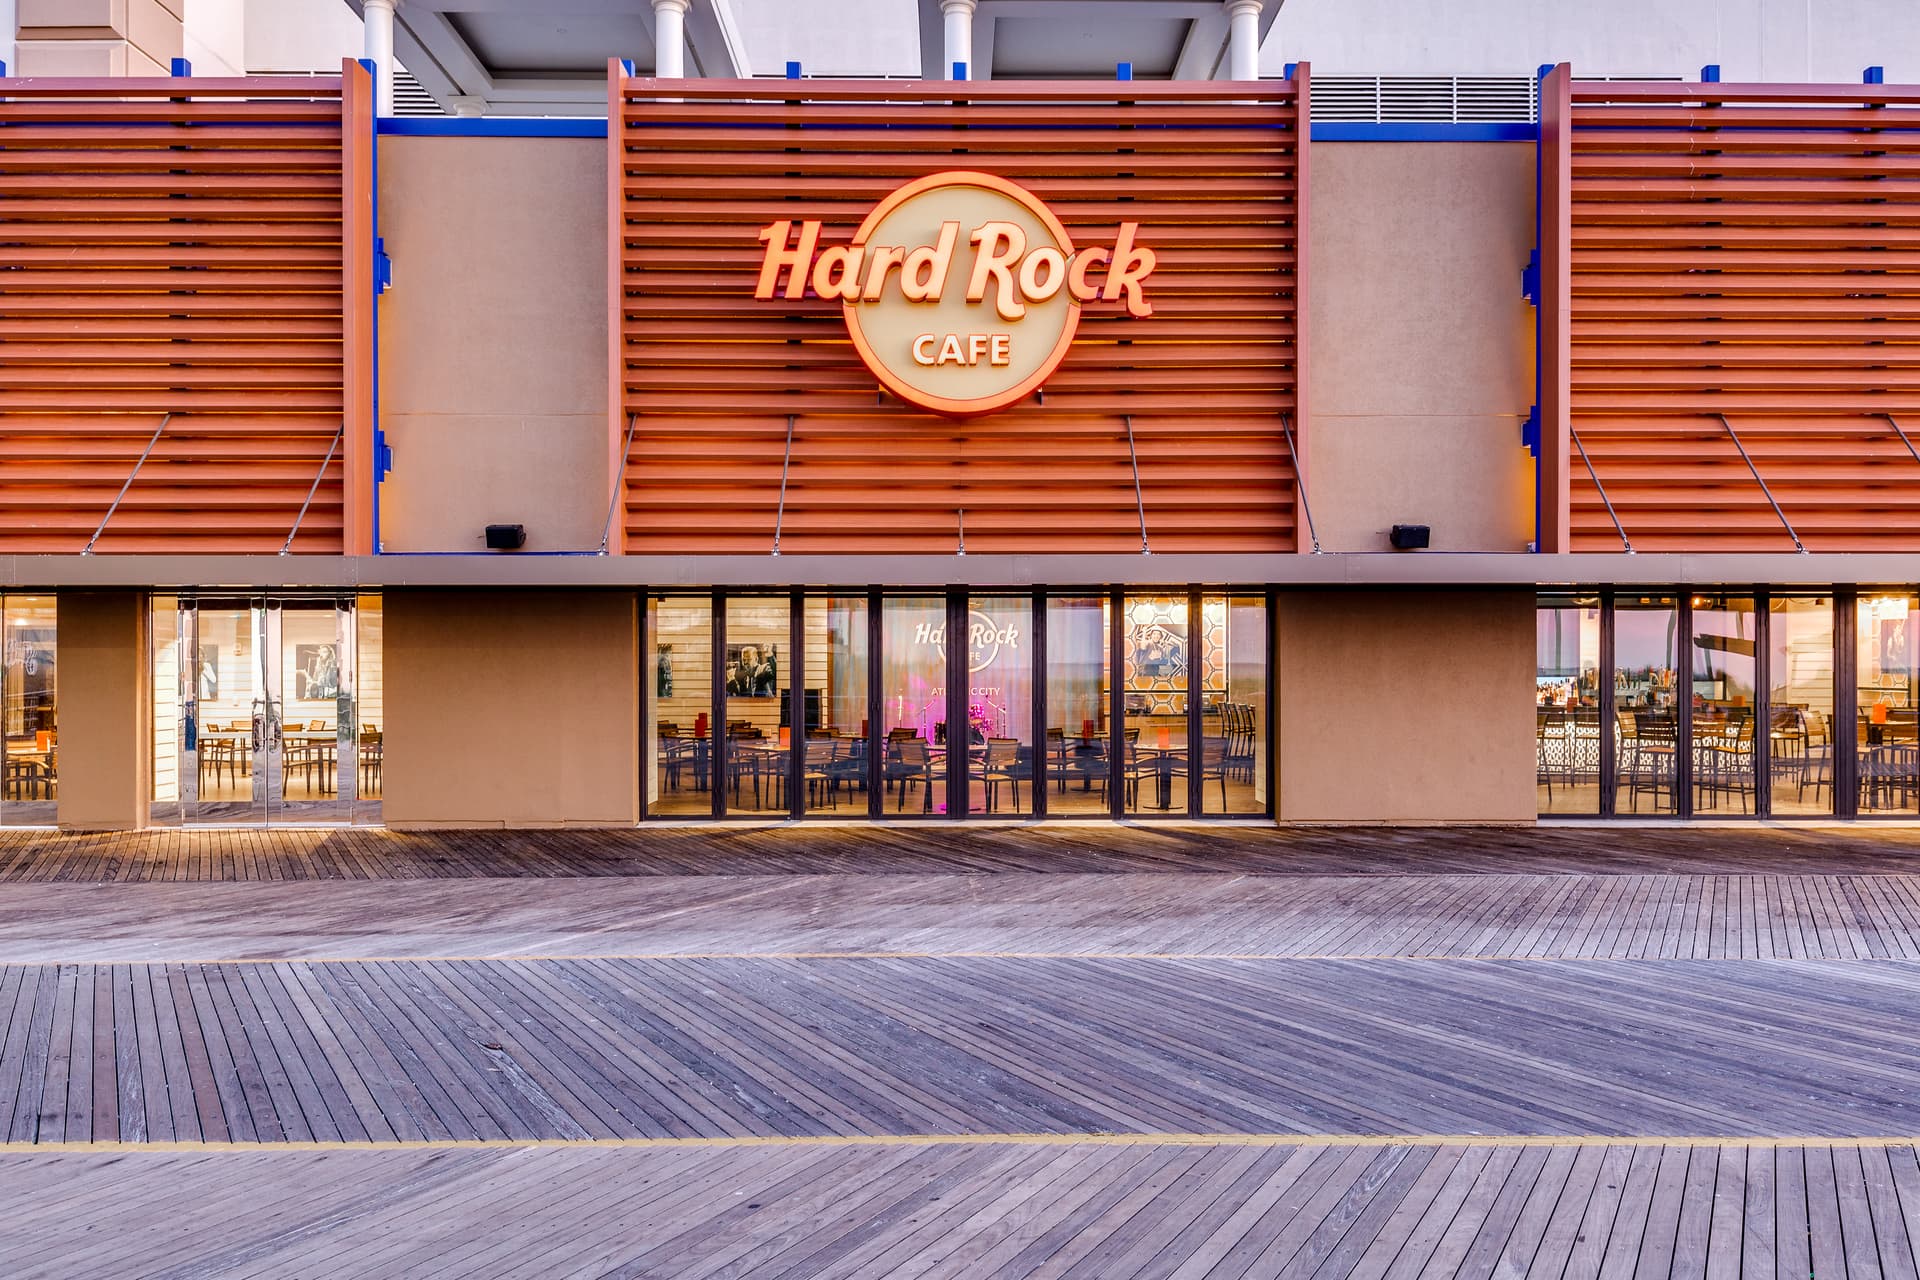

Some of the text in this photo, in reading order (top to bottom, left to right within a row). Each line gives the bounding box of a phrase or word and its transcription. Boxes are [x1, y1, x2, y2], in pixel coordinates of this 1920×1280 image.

[754, 220, 1157, 321] Hard Rock
[912, 333, 1011, 366] CAFE
[914, 623, 1019, 648] Ha Rock
[979, 687, 1000, 696] CITY
